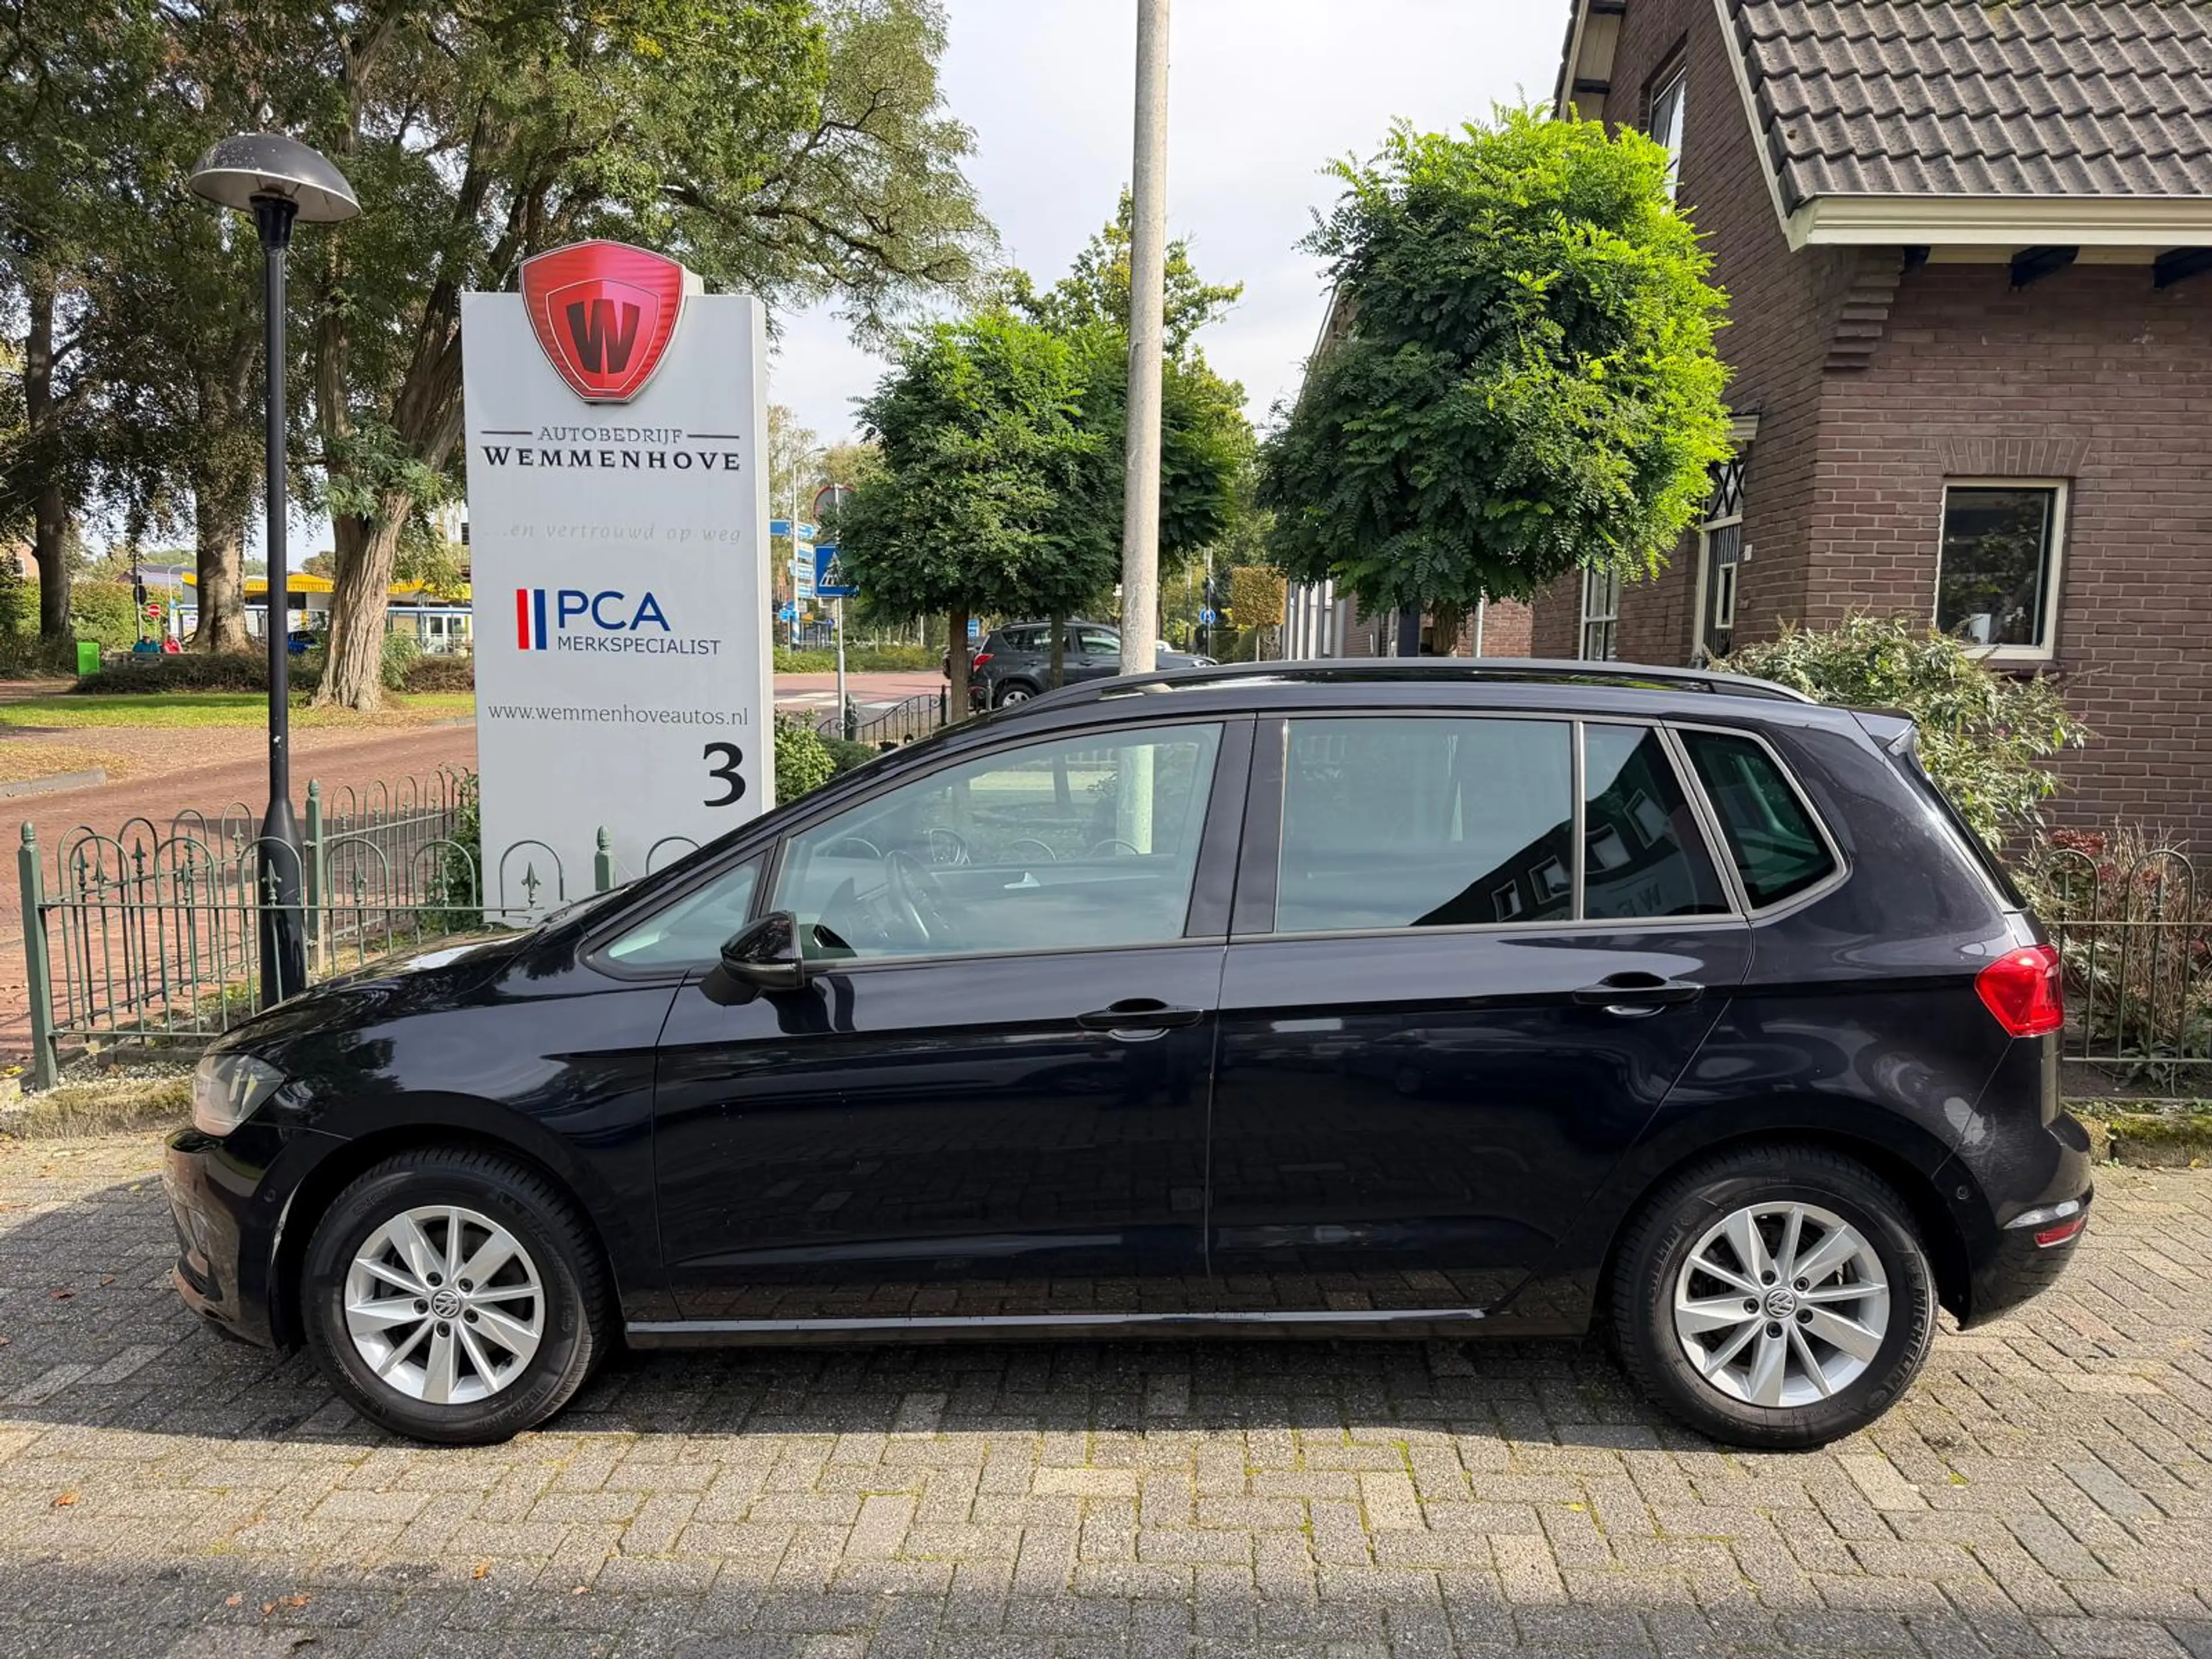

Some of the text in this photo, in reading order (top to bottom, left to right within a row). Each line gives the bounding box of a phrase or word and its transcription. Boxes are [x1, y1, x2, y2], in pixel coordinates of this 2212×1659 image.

[566, 298, 641, 374] W
[537, 426, 683, 444] AUTOBEDRIJF
[481, 446, 740, 470] WEMMENHOVE
[546, 523, 655, 540] vertrouwd
[666, 527, 691, 543] op
[702, 528, 742, 544] weg
[558, 590, 671, 631] PCA
[558, 636, 721, 655] MERKSPECIALIST
[488, 704, 748, 726] www.wemmenhoveautos.nl
[703, 742, 746, 807] 3
[1884, 1286, 1926, 1392] MICHELIN
